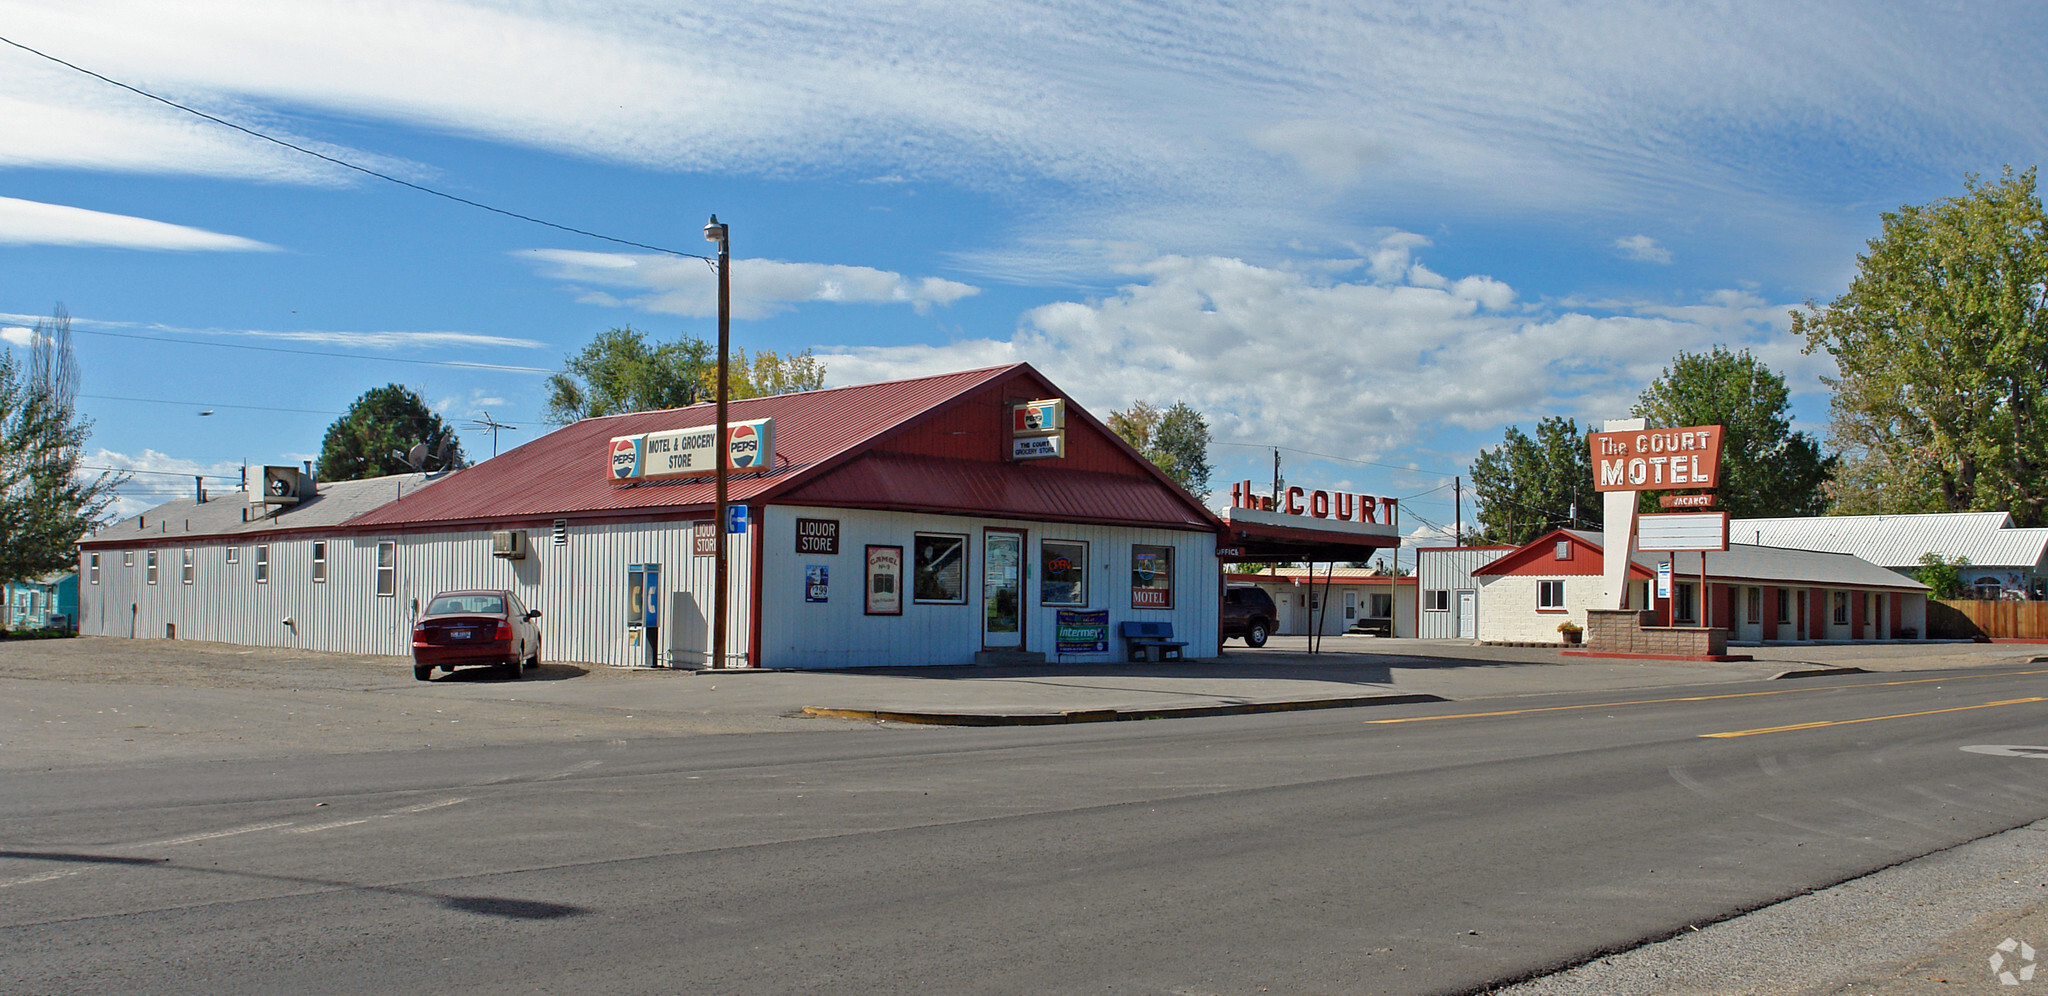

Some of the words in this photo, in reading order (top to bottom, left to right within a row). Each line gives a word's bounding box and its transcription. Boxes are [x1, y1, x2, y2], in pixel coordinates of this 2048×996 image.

[648, 438, 671, 454] MOTEL
[673, 437, 679, 450] &
[681, 433, 716, 449] GROCERY
[730, 439, 758, 453] PEPSI
[1598, 437, 1627, 455] The
[1636, 431, 1711, 453] COURT
[612, 452, 636, 465] PEPSI
[668, 453, 692, 469] STORE
[1600, 455, 1709, 486] MOTEL
[1230, 480, 1273, 512] the
[1285, 486, 1398, 526] COURT
[1673, 496, 1709, 505] VACANCY
[695, 523, 716, 538] LIQUO
[800, 521, 836, 537] LIQUOR
[801, 537, 833, 551] STORE
[1216, 548, 1239, 556] OFFICE
[869, 556, 898, 567] CAMEL
[1048, 559, 1071, 571] OPEN
[1132, 591, 1165, 604] MOTEL
